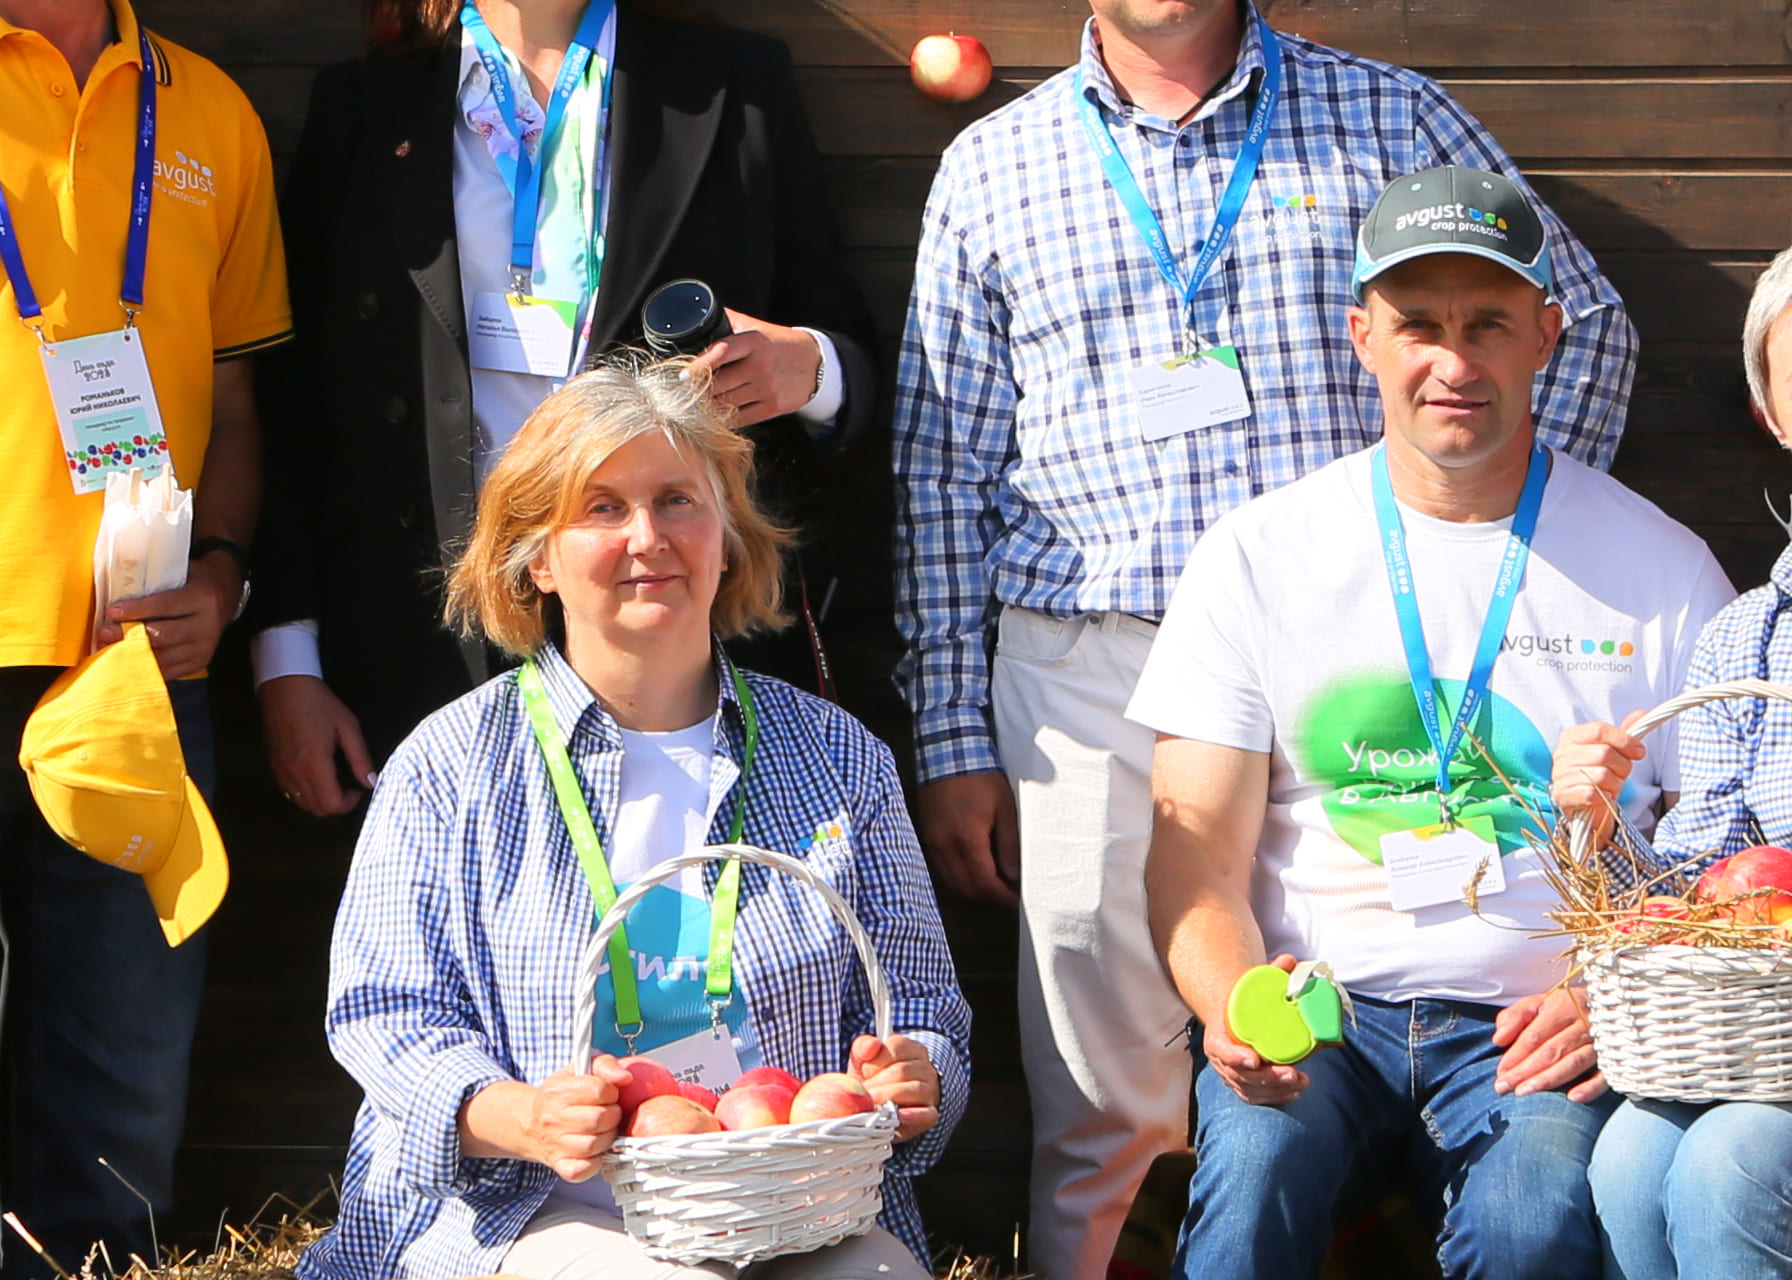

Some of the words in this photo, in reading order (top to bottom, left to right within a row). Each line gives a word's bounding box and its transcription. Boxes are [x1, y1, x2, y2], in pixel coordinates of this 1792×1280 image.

[154, 159, 217, 198] avgust
[1395, 202, 1465, 231] avgust
[1431, 221, 1455, 231] crop
[1458, 222, 1508, 240] protection
[1536, 658, 1563, 671] crop
[1566, 659, 1633, 673] protection
